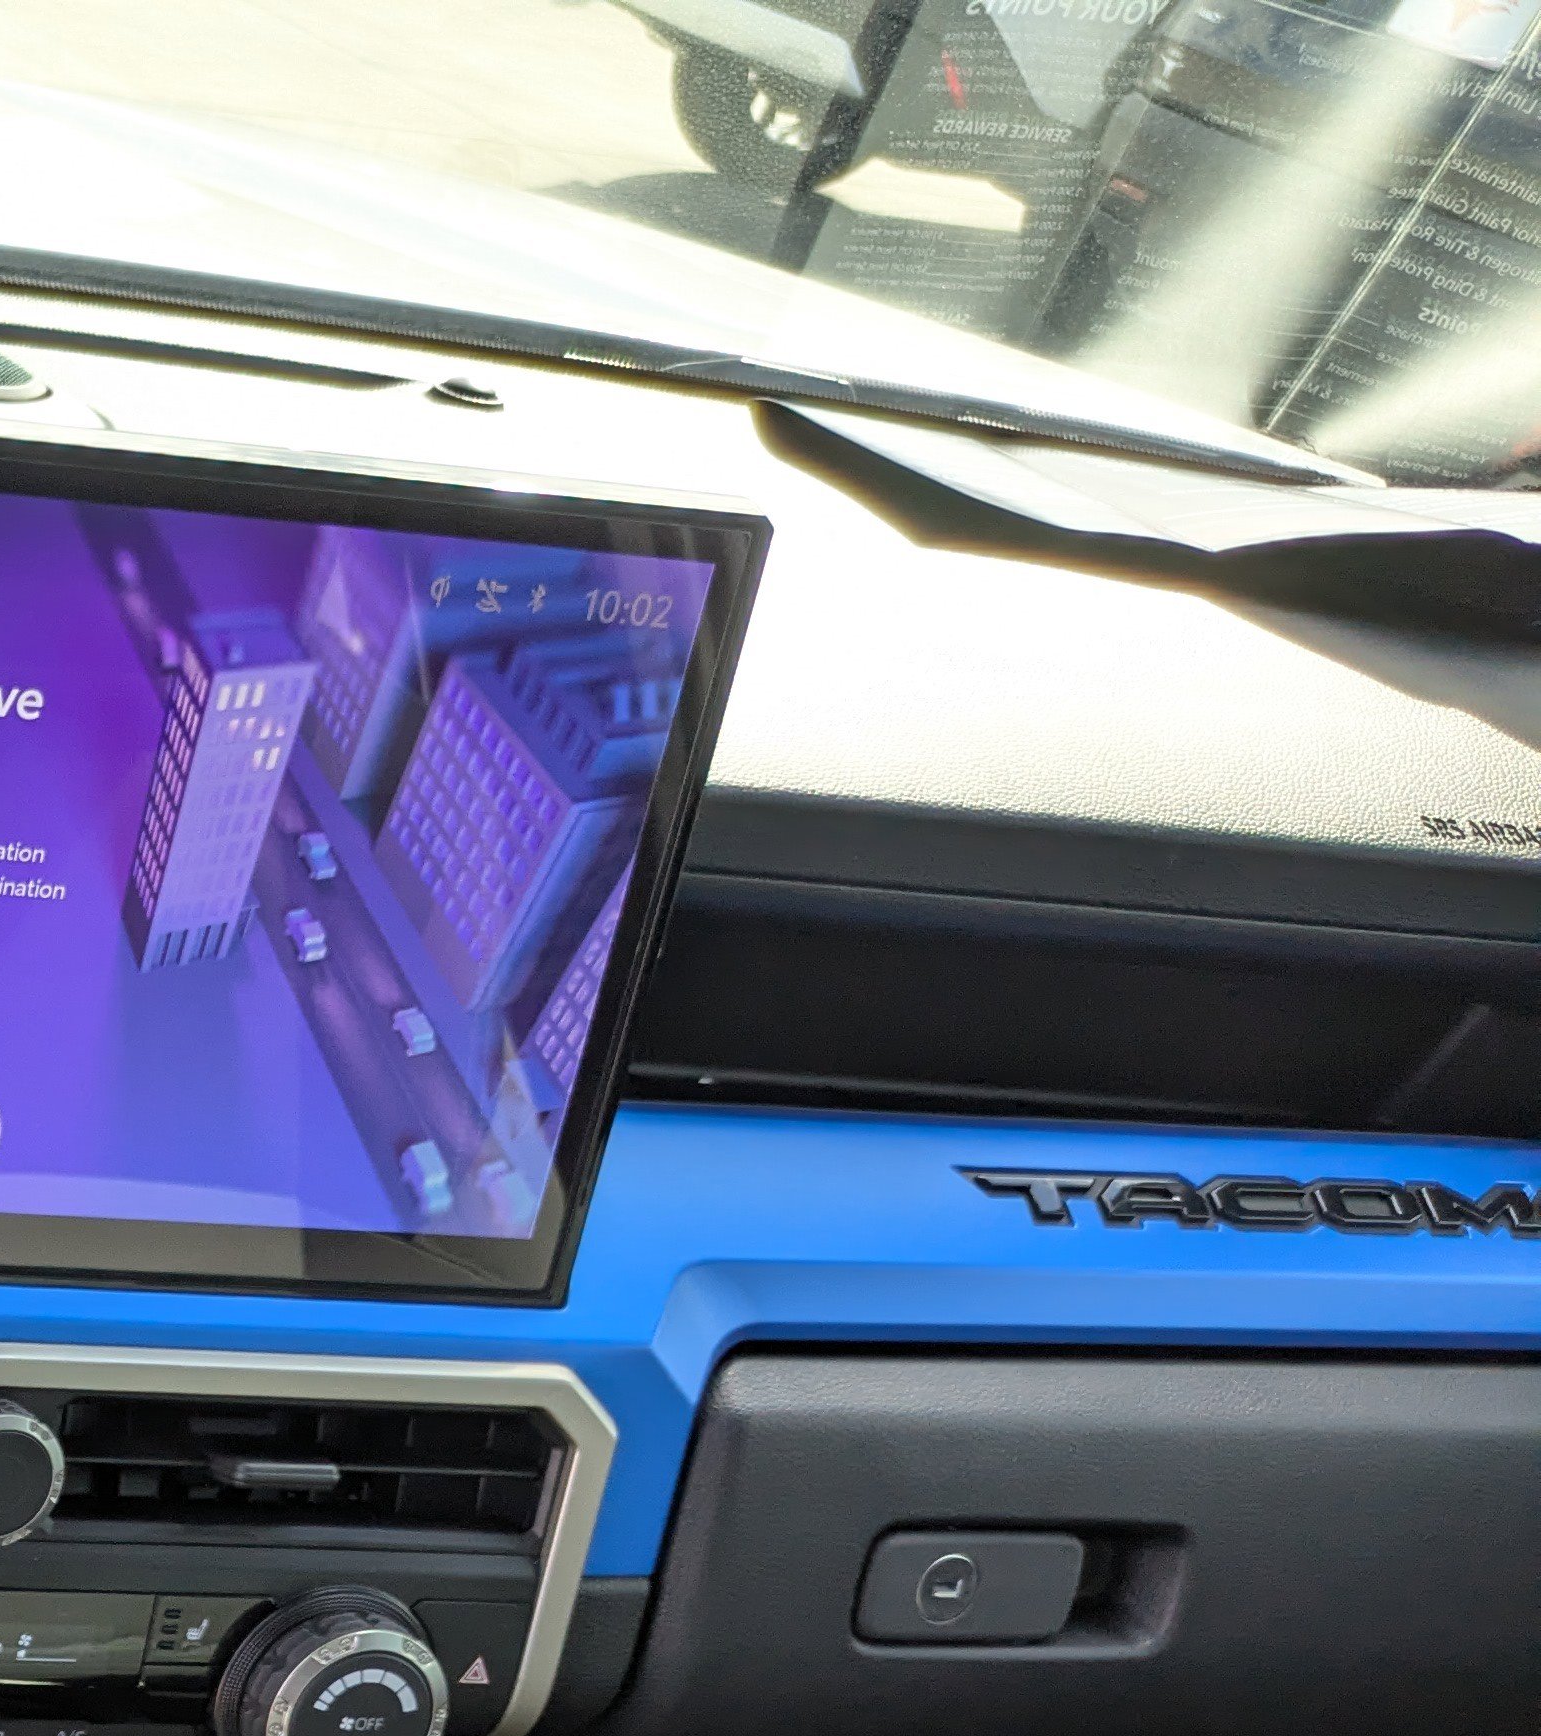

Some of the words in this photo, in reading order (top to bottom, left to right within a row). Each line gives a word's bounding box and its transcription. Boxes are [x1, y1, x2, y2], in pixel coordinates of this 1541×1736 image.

[583, 588, 674, 632] 10:02
[1467, 819, 1541, 848] AIRBA
[950, 1163, 1541, 1240] TACOM
[353, 1715, 385, 1732] OFF
